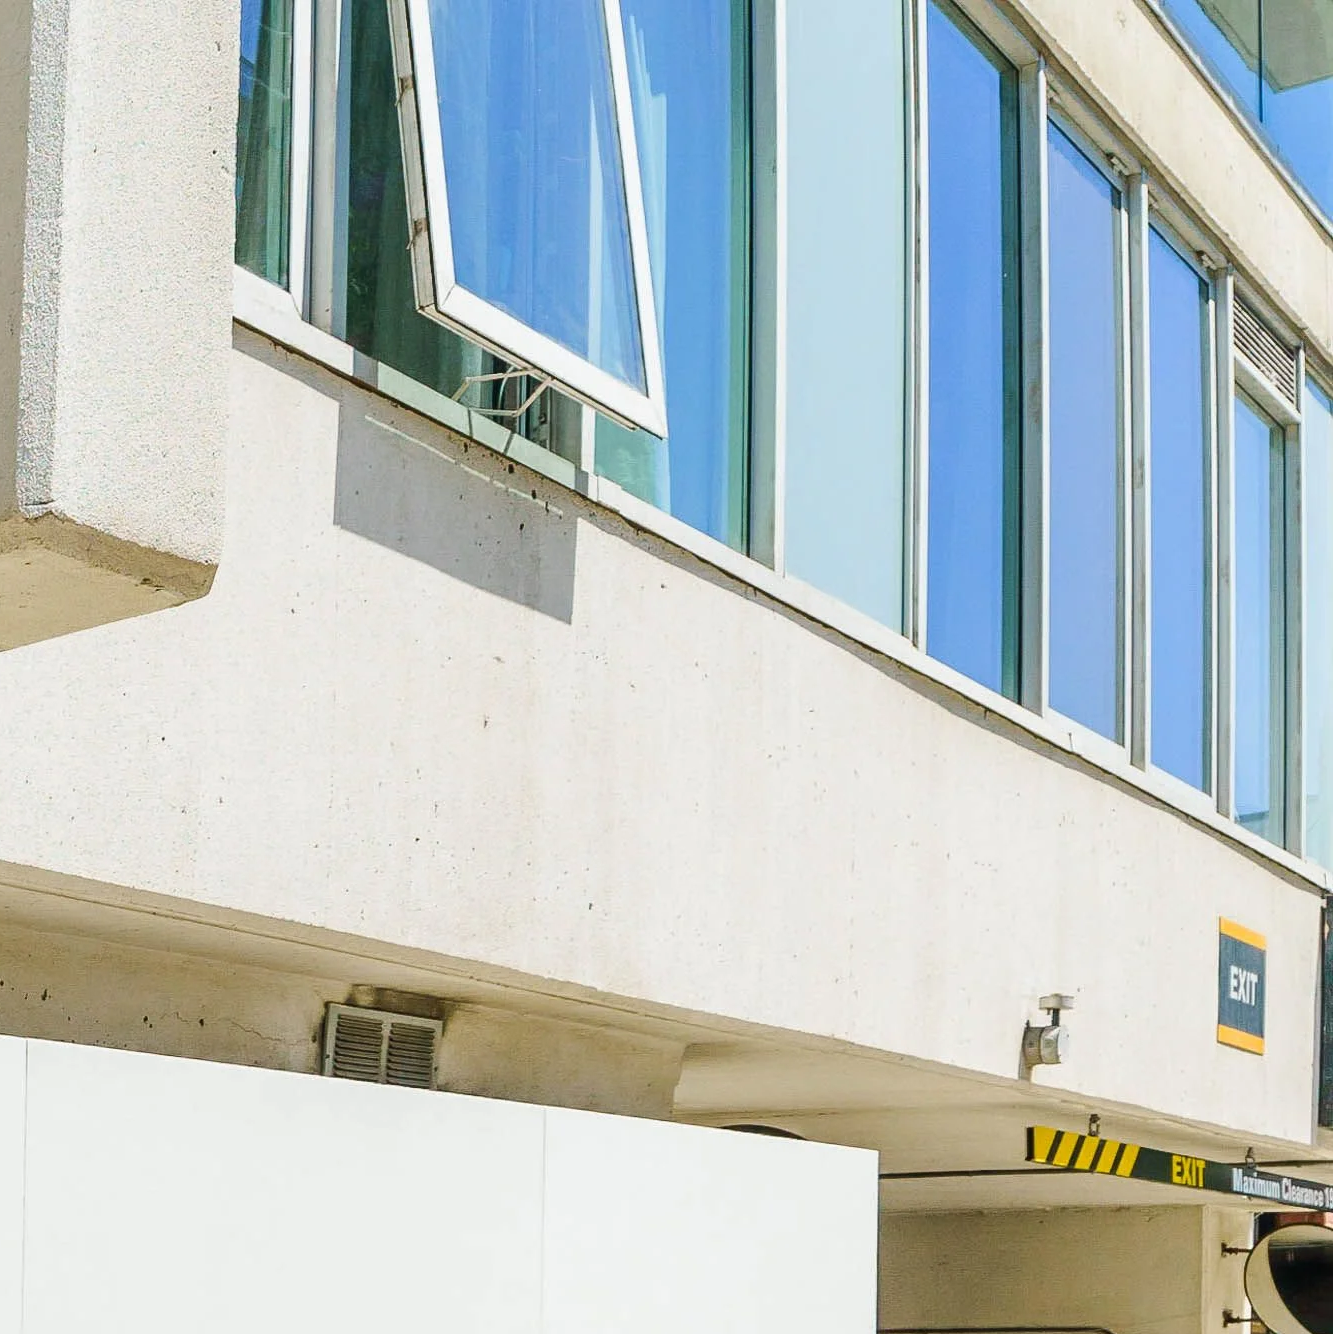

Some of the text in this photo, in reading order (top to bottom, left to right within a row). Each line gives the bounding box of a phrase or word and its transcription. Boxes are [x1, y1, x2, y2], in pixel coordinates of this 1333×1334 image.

[1230, 964, 1259, 1006] EXIT
[1171, 1154, 1206, 1188] EXIT
[1233, 1167, 1281, 1199] Maximum
[1282, 1177, 1324, 1207] Clearance
